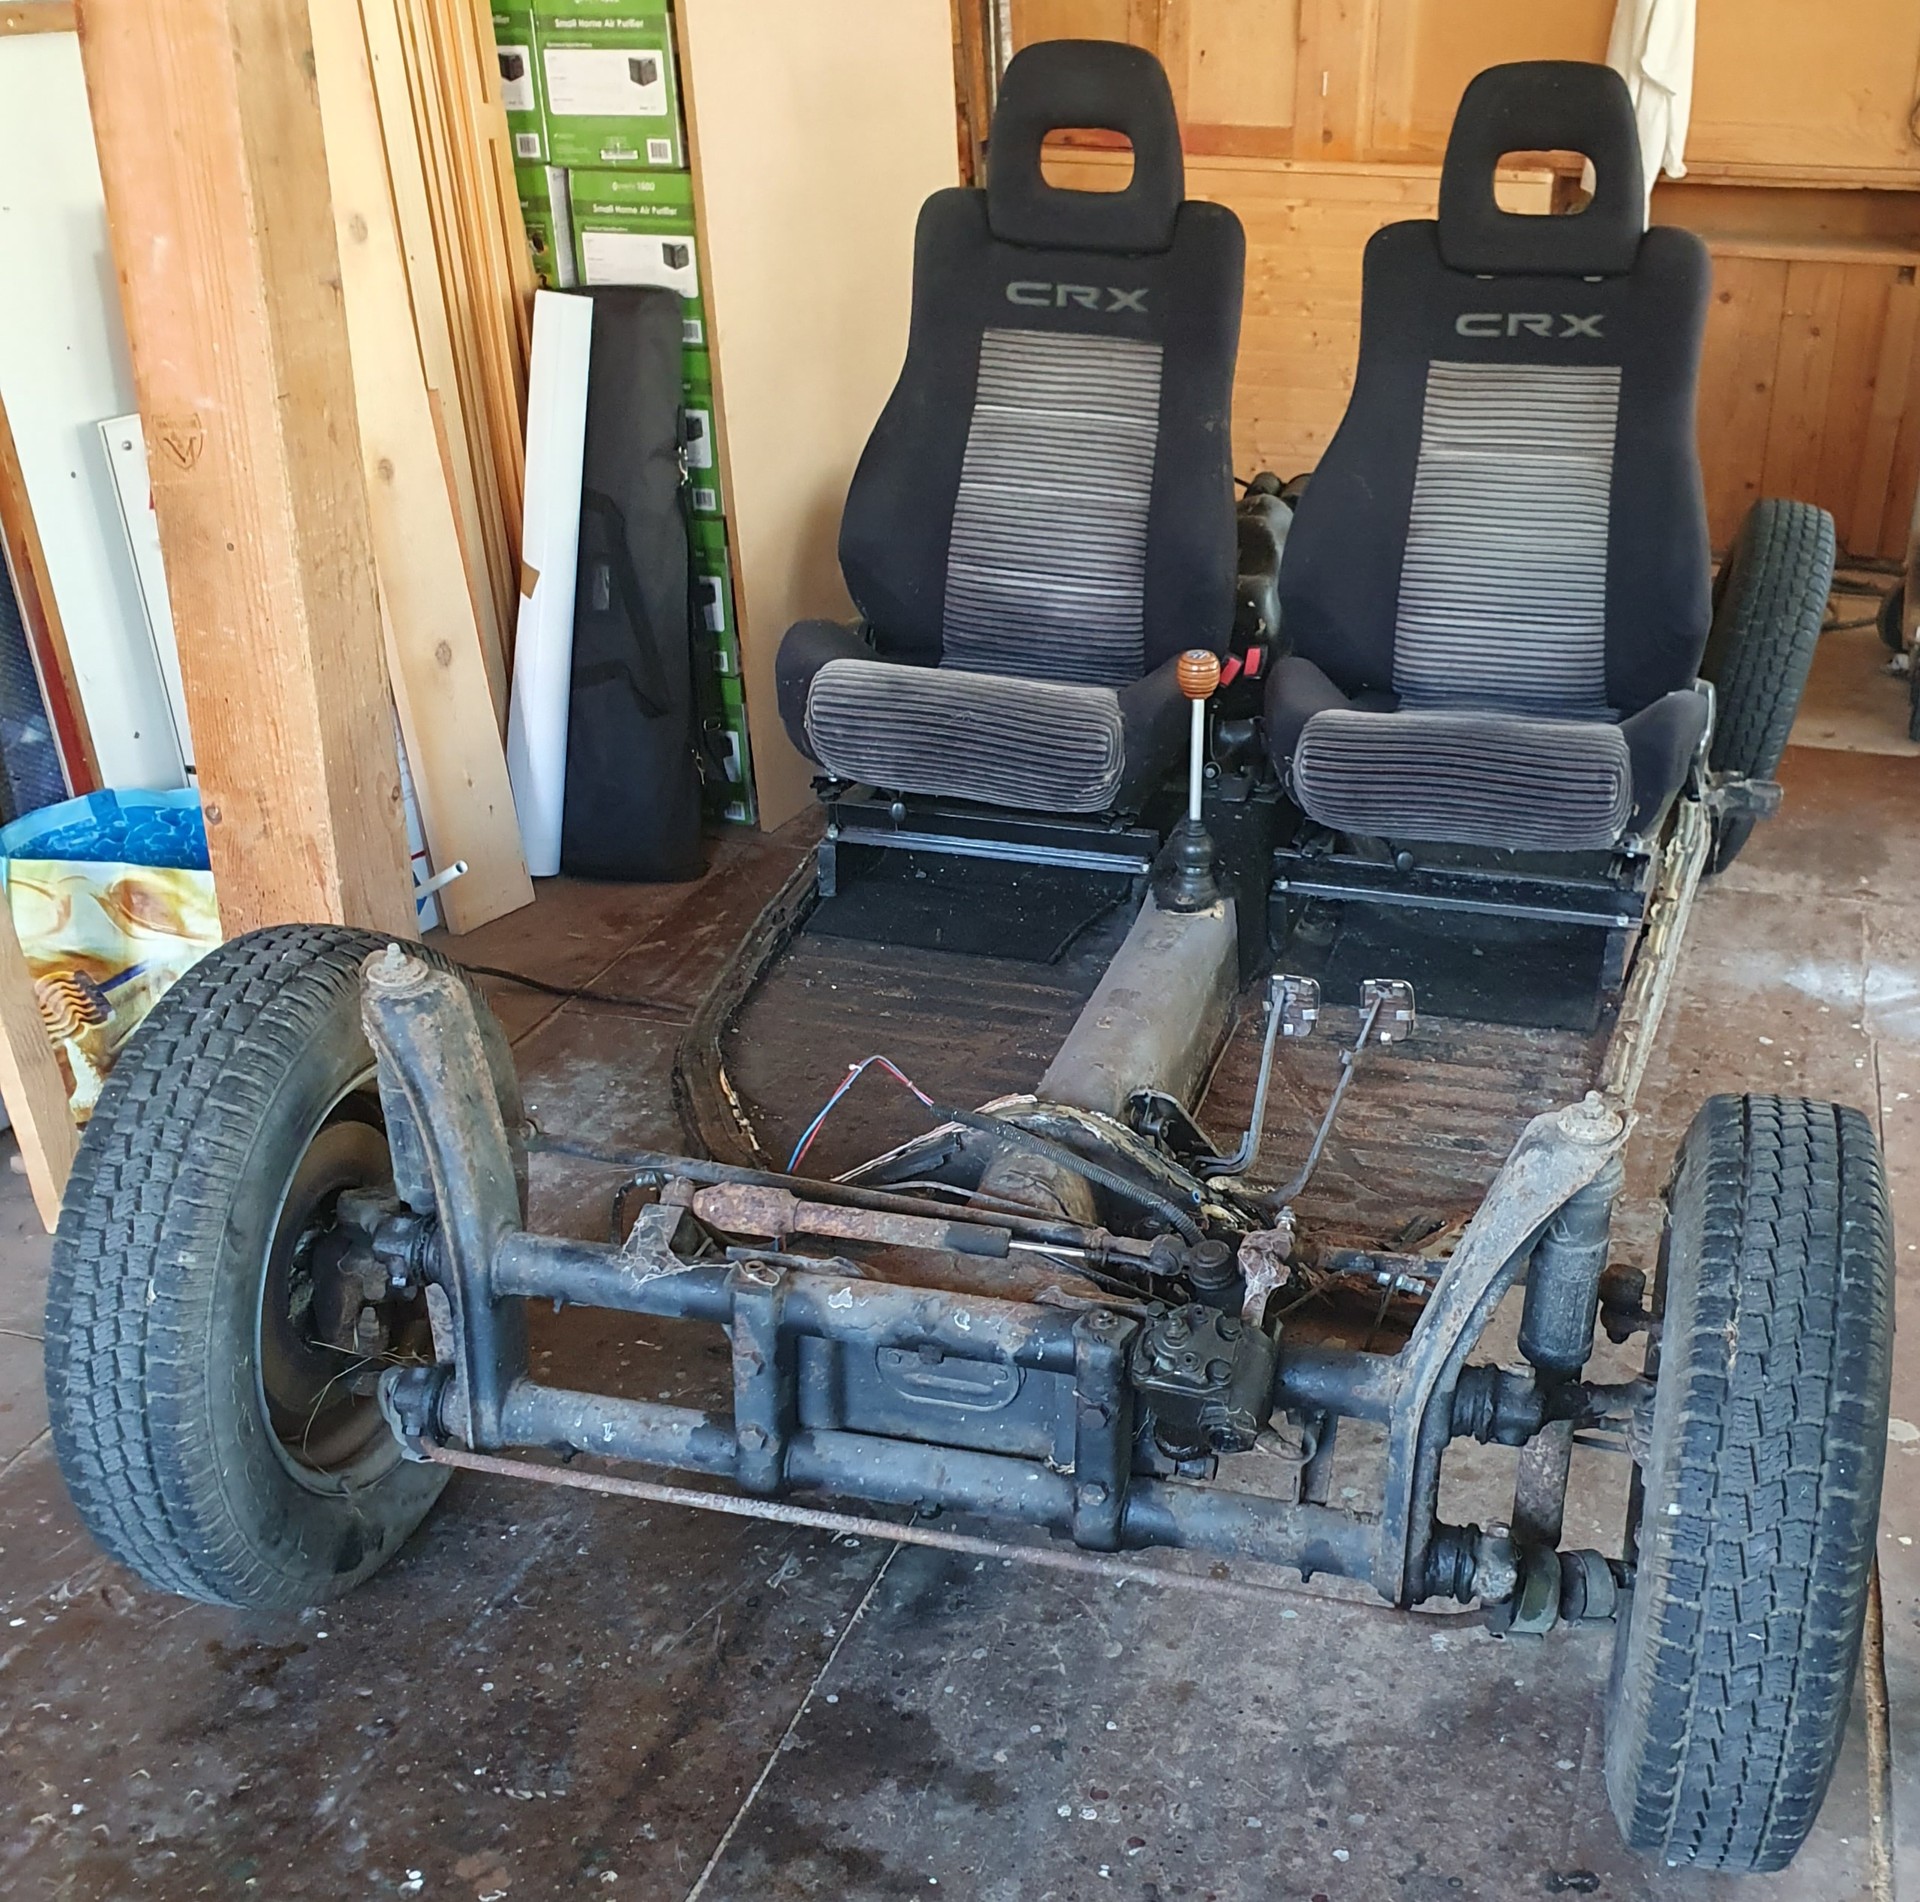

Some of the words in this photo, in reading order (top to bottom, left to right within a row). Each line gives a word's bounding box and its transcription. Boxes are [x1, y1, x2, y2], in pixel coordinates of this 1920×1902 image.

[555, 18, 577, 28] Small
[578, 19, 602, 28] Home
[604, 19, 615, 28] Air
[617, 18, 644, 28] Purifier
[593, 203, 614, 213] Small
[615, 205, 638, 214] Home
[640, 206, 650, 215] Air
[652, 206, 677, 216] Purifier
[1006, 281, 1149, 312] CRX
[1455, 313, 1604, 338] CRX
